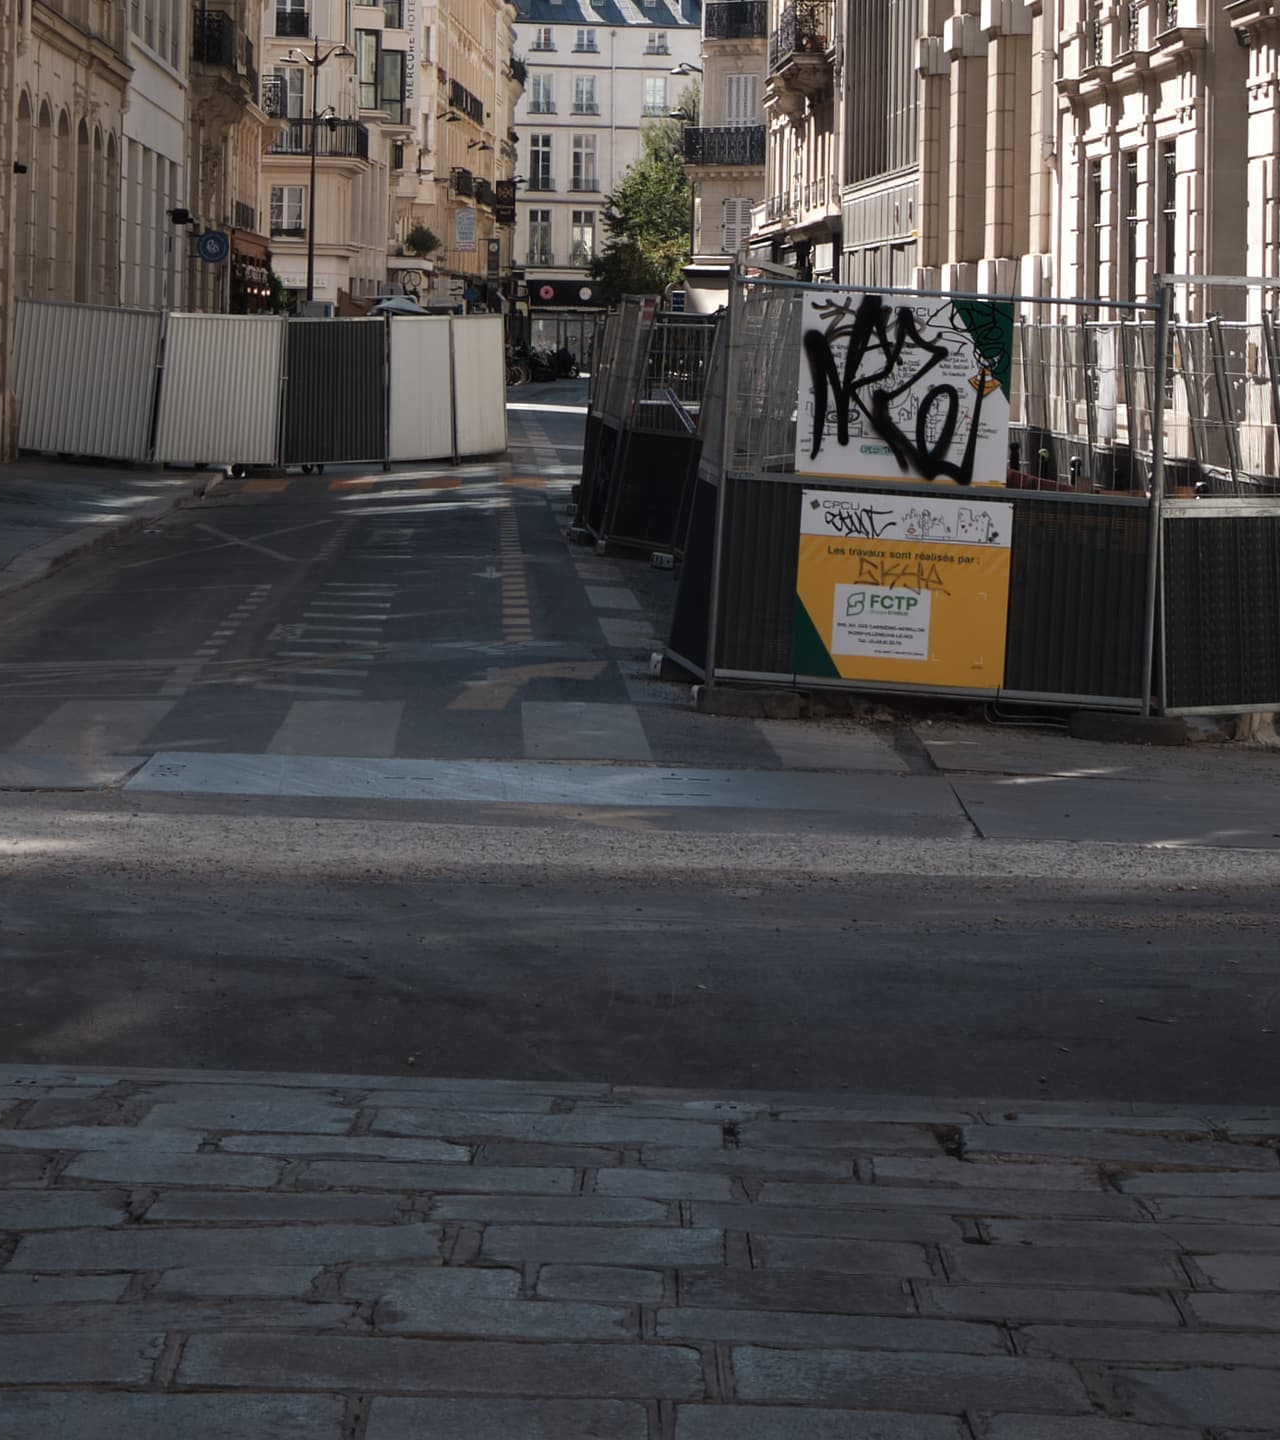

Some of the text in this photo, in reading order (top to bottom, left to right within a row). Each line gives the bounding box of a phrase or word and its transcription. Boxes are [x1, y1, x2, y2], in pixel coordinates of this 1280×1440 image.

[822, 500, 861, 511] CPCU
[827, 546, 846, 556] Les
[849, 548, 886, 558] travaux
[889, 550, 912, 560] sont
[914, 551, 955, 564] réalisés
[958, 555, 975, 564] par
[870, 594, 918, 611] FCTP
